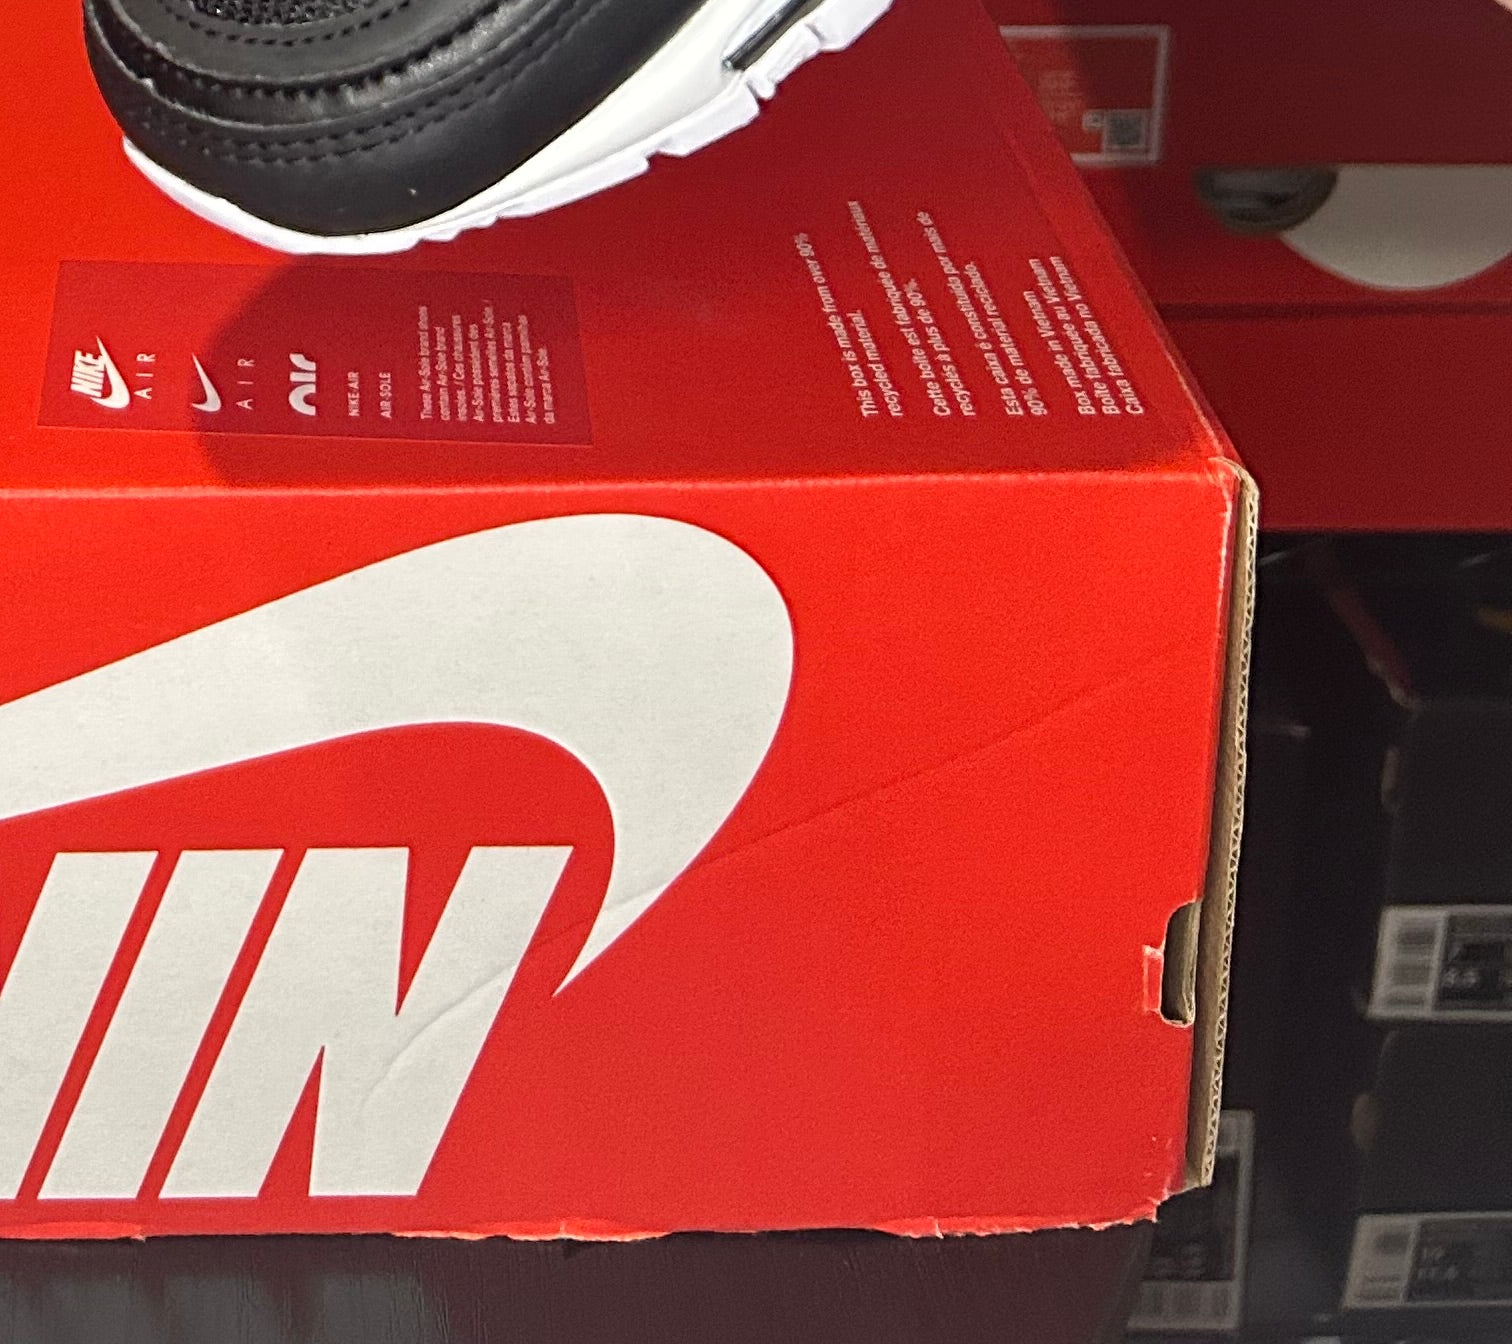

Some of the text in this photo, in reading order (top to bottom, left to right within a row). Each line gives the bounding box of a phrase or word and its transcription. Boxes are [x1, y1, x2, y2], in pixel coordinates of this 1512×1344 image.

[69, 351, 106, 398] NIKE
[134, 353, 155, 399] AIR
[794, 233, 878, 416] This box is made from over 90%
[846, 310, 902, 416] recycled material.
[1023, 290, 1096, 414] Box made in Vietnam
[1028, 258, 1120, 414] Boîte fabriquée au Vietnam
[1049, 256, 1143, 414] Caixa fabricada no Vietnam
[236, 358, 254, 410] AIR
[379, 372, 391, 418] AIR-SOLE
